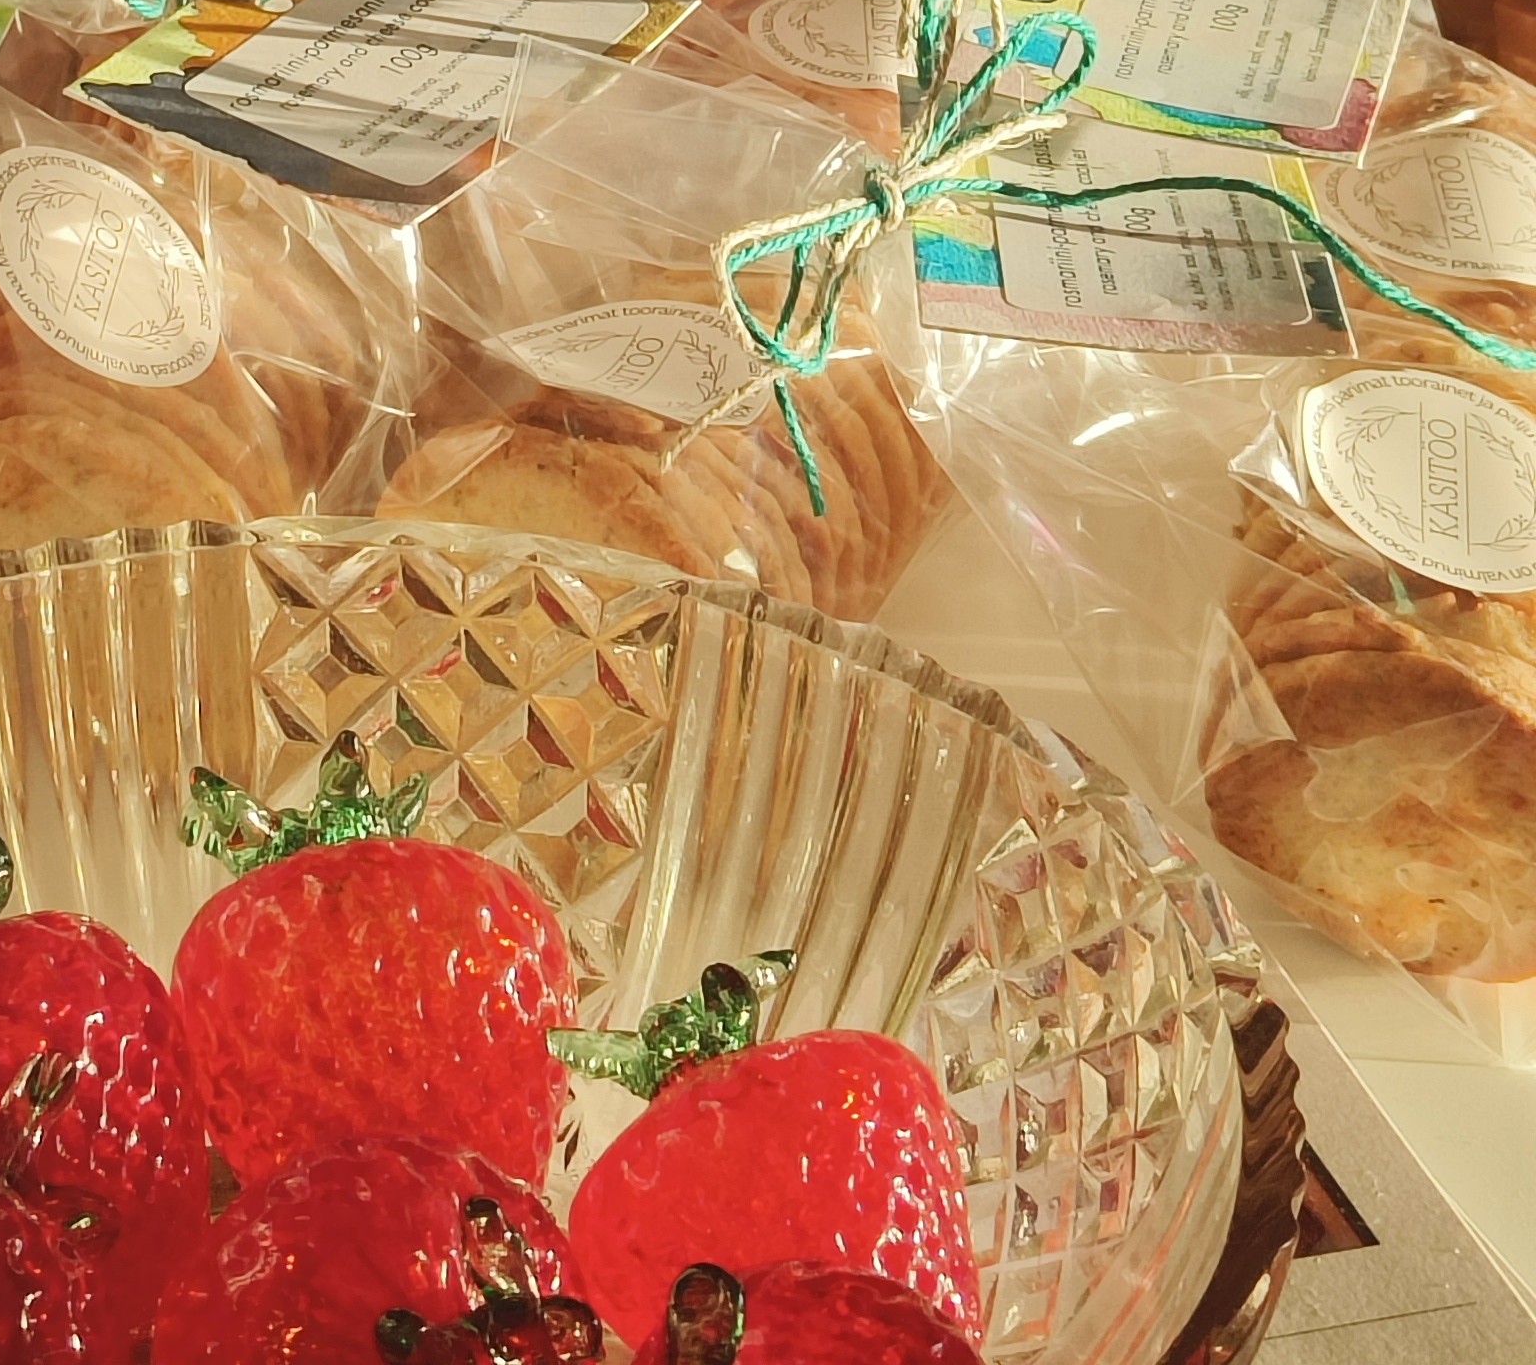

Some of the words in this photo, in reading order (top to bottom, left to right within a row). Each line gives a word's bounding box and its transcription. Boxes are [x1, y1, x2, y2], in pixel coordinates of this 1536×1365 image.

[1209, 3, 1249, 32] 100g
[279, 65, 346, 111] rosemary
[339, 43, 368, 68] and
[380, 42, 438, 75] 100g
[1431, 155, 1481, 242] KÄSITÖÖ
[73, 208, 125, 322] KÄSITÖÖ
[54, 327, 129, 374] valminud
[1391, 374, 1476, 403] toorainet
[1475, 394, 1495, 410] ja
[1423, 418, 1460, 541] KÄSITÖÖ
